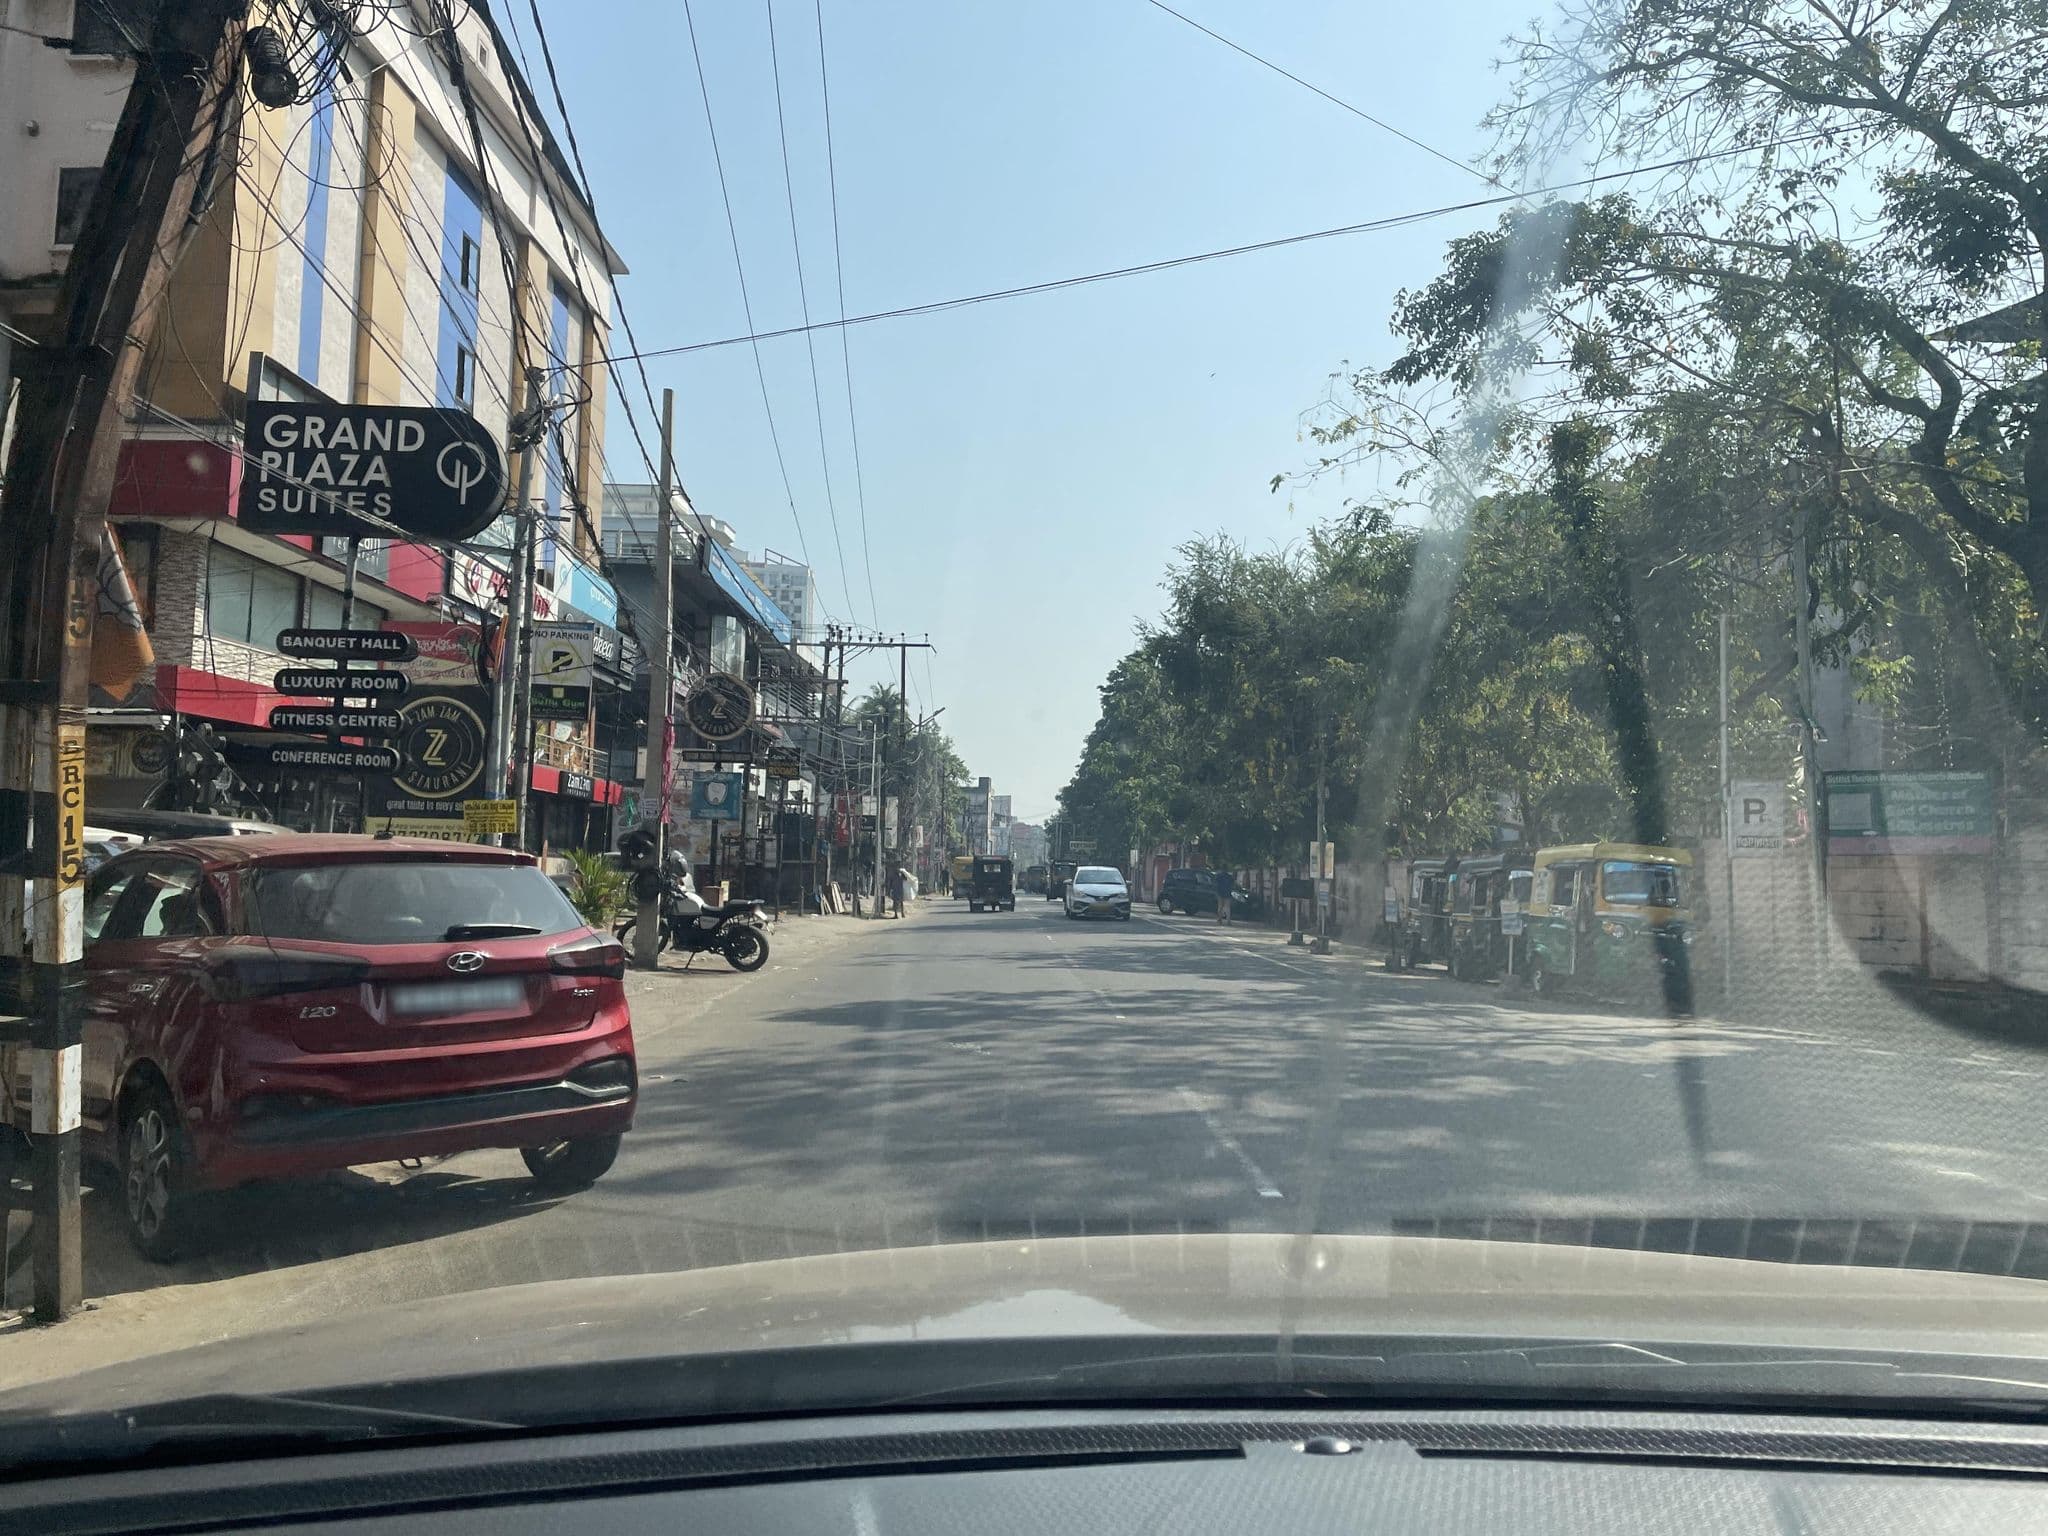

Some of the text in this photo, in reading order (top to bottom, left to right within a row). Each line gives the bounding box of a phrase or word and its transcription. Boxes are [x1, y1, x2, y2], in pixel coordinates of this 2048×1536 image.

[263, 414, 425, 452] GRAND
[260, 450, 393, 488] PLAZA
[257, 488, 393, 517] SUITES
[282, 636, 402, 650] BANQUET HALL
[550, 631, 590, 641] PARKING
[281, 676, 399, 690] LUXURY ROOM
[273, 714, 397, 728] FITNESS CENTRE
[272, 750, 391, 767] CONFERENCE ROOM
